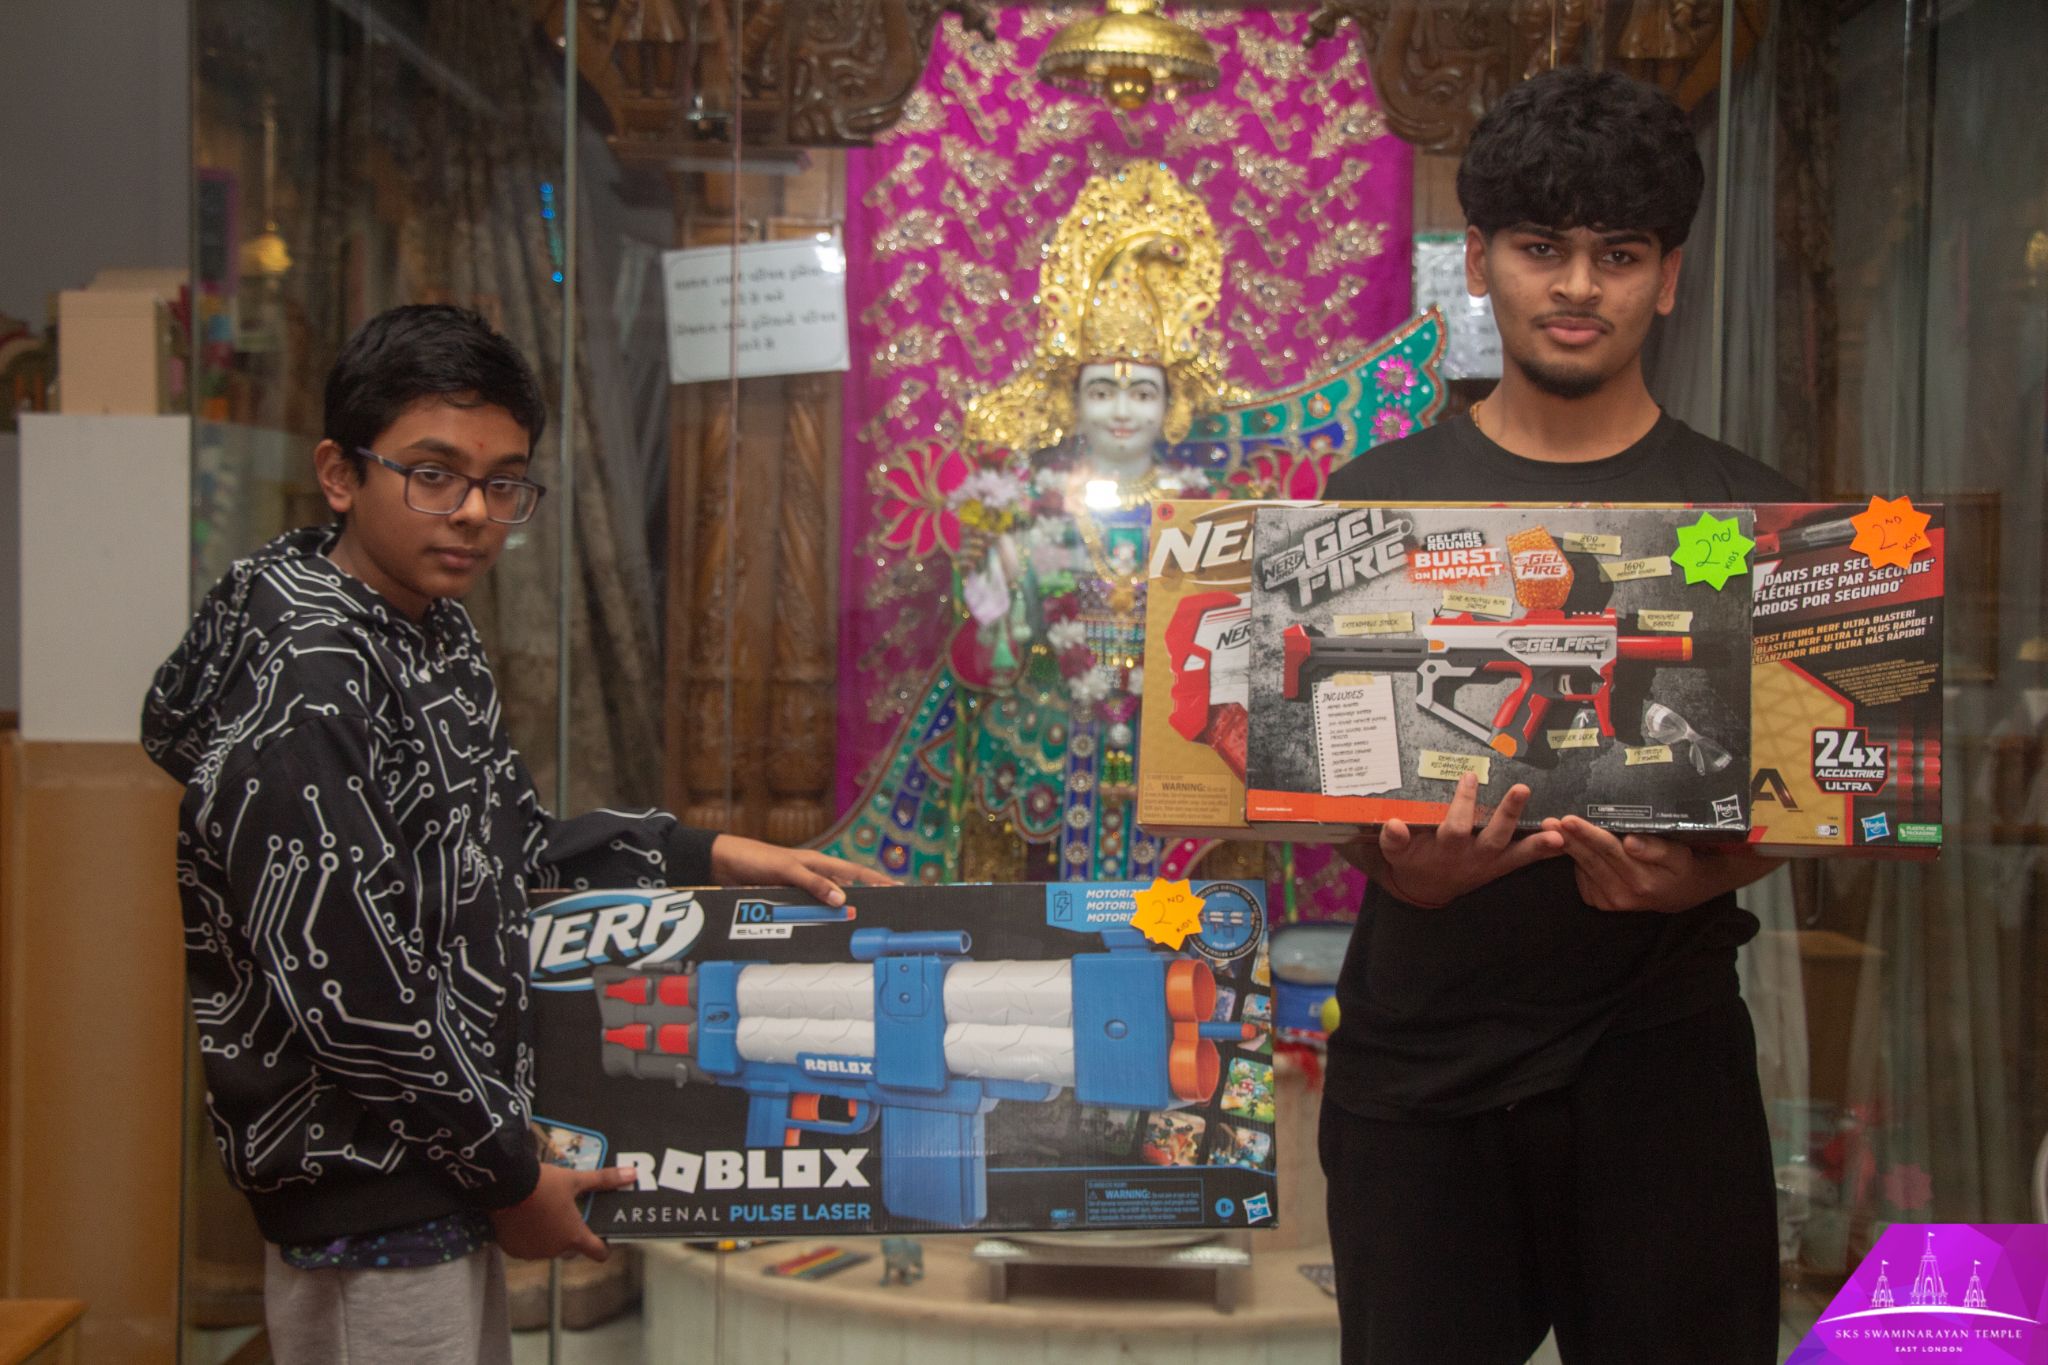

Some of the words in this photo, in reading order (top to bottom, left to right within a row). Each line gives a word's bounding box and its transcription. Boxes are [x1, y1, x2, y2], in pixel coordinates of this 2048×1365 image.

[1427, 531, 1482, 544] GELFIRE
[1427, 540, 1482, 551] ROUNDS
[1414, 548, 1501, 568] BURST
[1624, 561, 1645, 570] 1600
[1296, 540, 1410, 607] FIRE
[1415, 572, 1431, 580] ON
[1432, 563, 1503, 581] IMPACT
[1764, 567, 1808, 586] DARTS
[1813, 562, 1840, 578] PER
[1844, 558, 1871, 573] SEC
[1754, 579, 1834, 602] FLÉCHETTES
[1838, 572, 1864, 588] PAR
[1752, 599, 1798, 617] ARDOS
[1802, 595, 1830, 609] POR
[1753, 633, 1780, 646] STEST
[1782, 627, 1814, 640] FIRING
[1817, 623, 1840, 634] NERF
[1843, 618, 1870, 630] ULTRA
[1873, 609, 1916, 623] BLASTER!
[1798, 637, 1821, 648] NERF
[1824, 631, 1851, 643] ULTRA
[1854, 628, 1864, 637] LE
[1867, 625, 1890, 635] PLUS
[1893, 619, 1927, 631] RAPIDE
[1809, 644, 1833, 655] NERF
[1835, 639, 1862, 651] ULTRA
[1865, 632, 1884, 645] MÁS
[1887, 627, 1925, 642] RÁPIDO!
[1322, 689, 1364, 702] INCLUDES
[1815, 731, 1885, 768] 24x
[1816, 769, 1885, 779] ACCUSTRIKE
[1825, 781, 1873, 791] ULTRA
[1087, 901, 1137, 911] MOTORIS
[1087, 913, 1136, 922] MOTORI
[737, 928, 786, 936] ELITE
[804, 1059, 874, 1075] ROBLOX
[616, 1148, 871, 1194] ROBLOX
[1105, 1190, 1150, 1199] WARNING:
[613, 1205, 721, 1223] ARSENAL
[730, 1204, 796, 1222] PULSE
[803, 1203, 871, 1220] LASER
